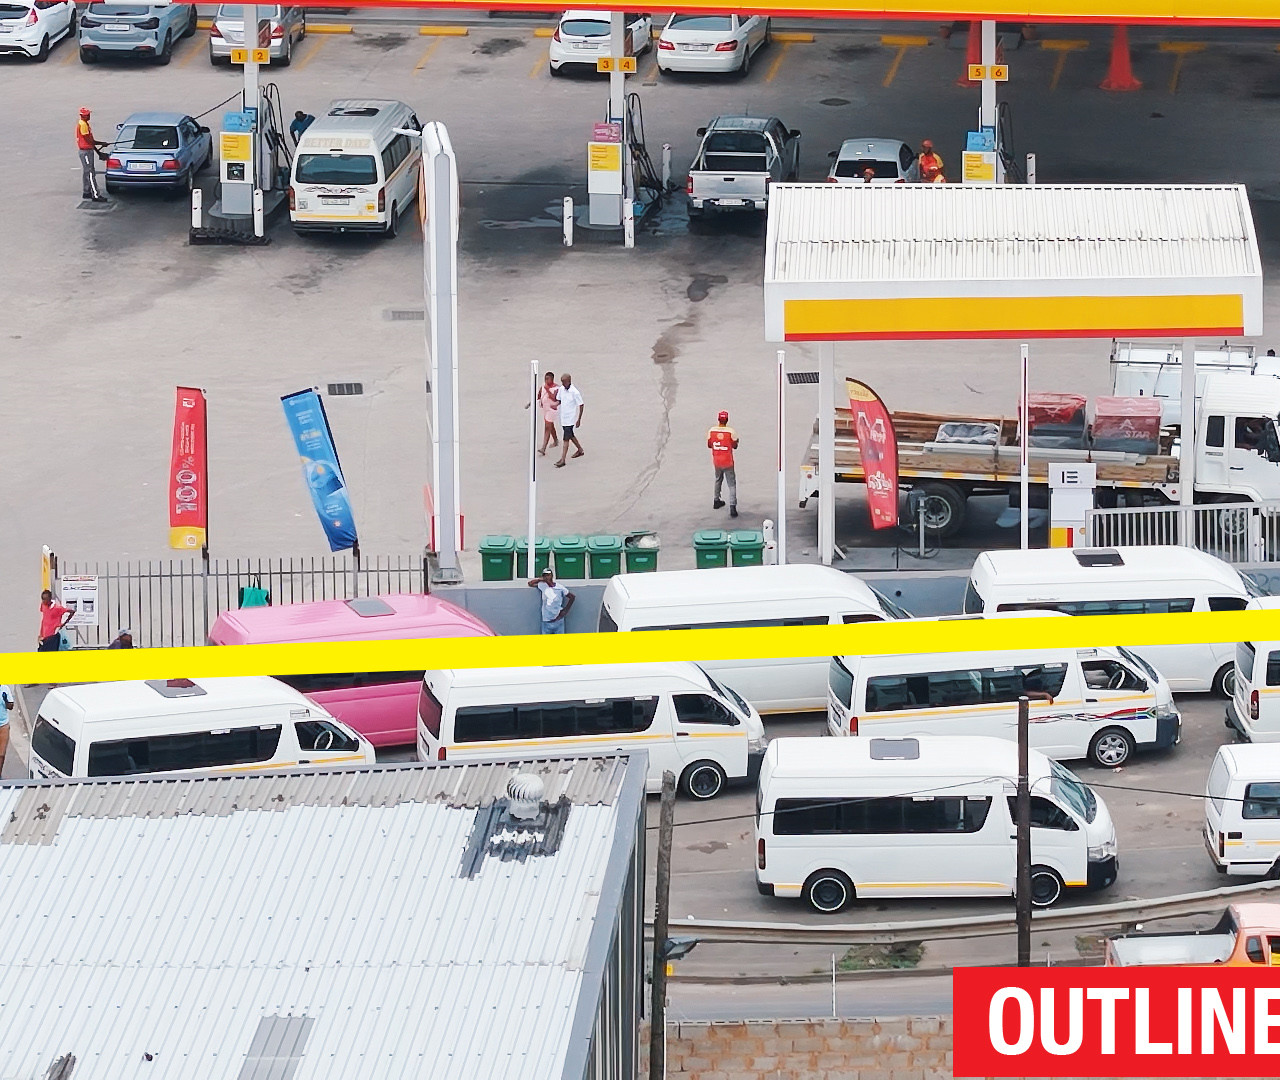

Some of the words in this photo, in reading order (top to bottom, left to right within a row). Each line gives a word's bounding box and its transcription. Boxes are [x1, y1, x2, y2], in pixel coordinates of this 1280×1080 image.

[257, 51, 263, 60] 2
[603, 60, 609, 69] 3
[623, 61, 630, 69] 4
[975, 68, 981, 76] 5
[995, 68, 1002, 76] 6
[1120, 419, 1135, 430] A
[1125, 431, 1150, 439] STAR
